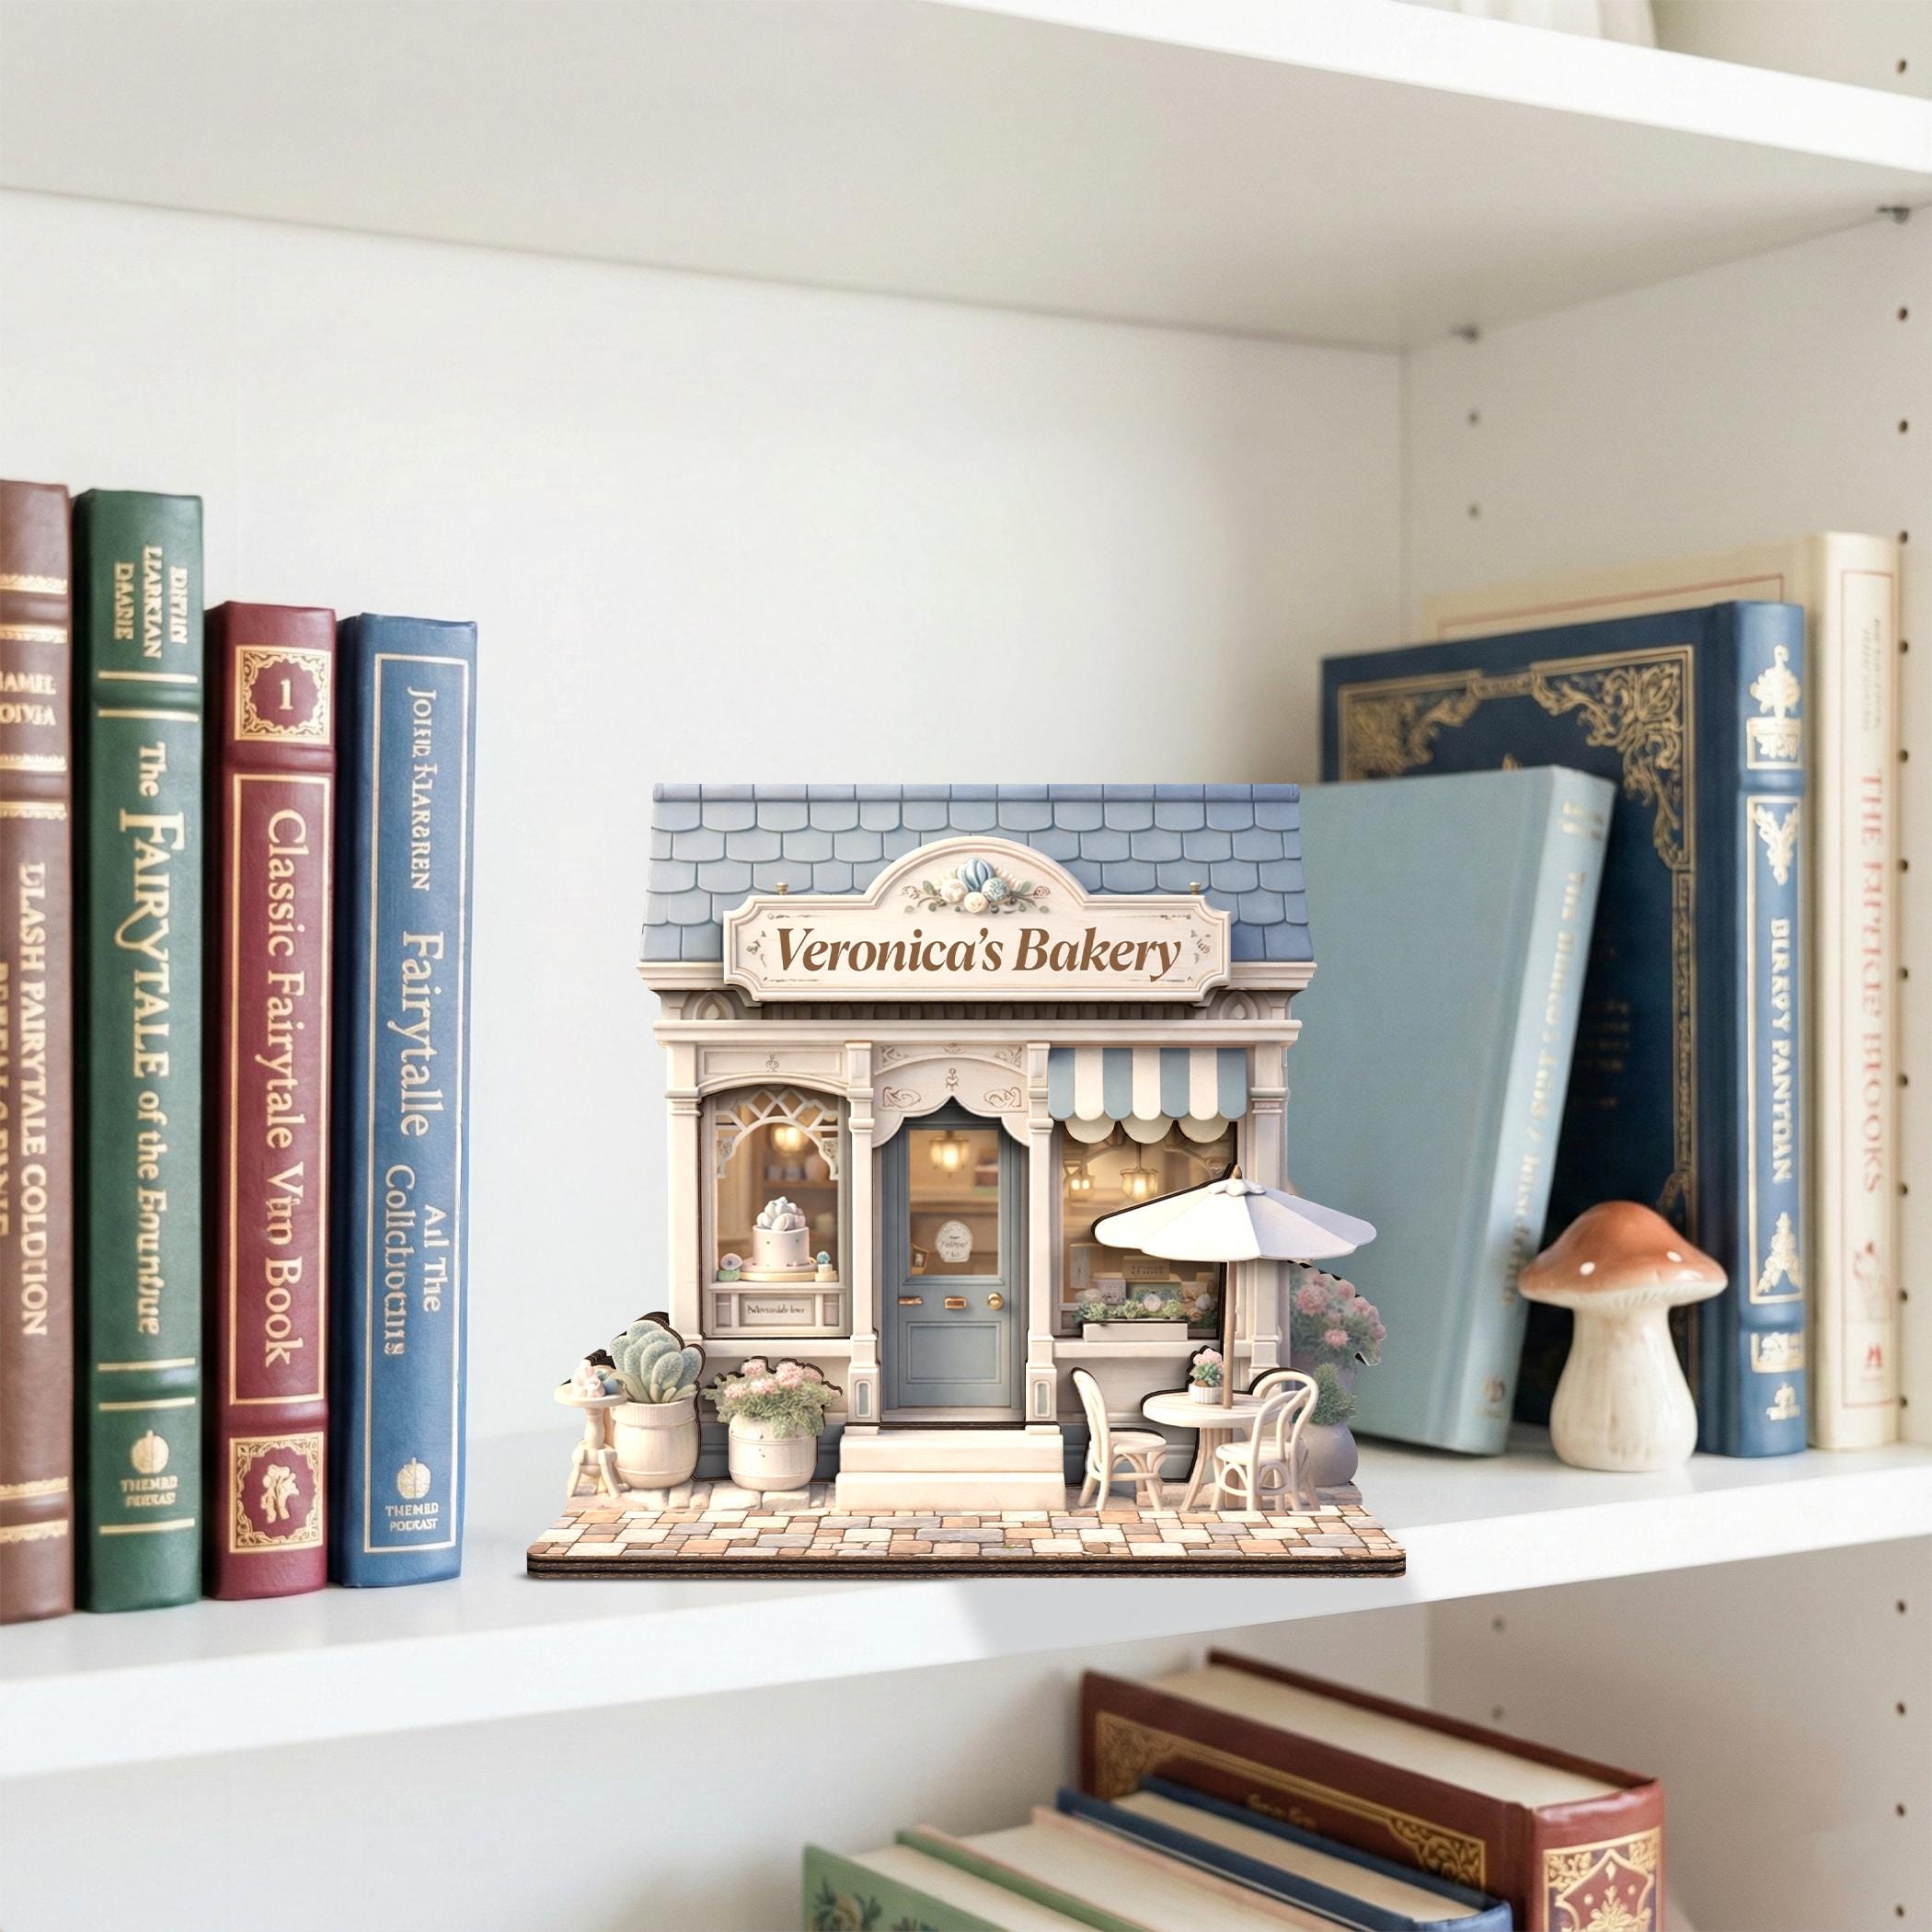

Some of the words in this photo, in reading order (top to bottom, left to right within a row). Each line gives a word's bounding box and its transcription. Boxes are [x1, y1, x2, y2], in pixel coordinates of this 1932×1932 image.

[139, 742, 167, 796] The
[267, 809, 308, 958] Classic
[776, 927, 1004, 972] Veronica's
[1012, 926, 1181, 982] Bakery
[255, 970, 306, 1148] Fairytale
[137, 1090, 167, 1126] of
[137, 1131, 168, 1179] the
[263, 1257, 302, 1368] Book
[422, 1257, 448, 1313] The
